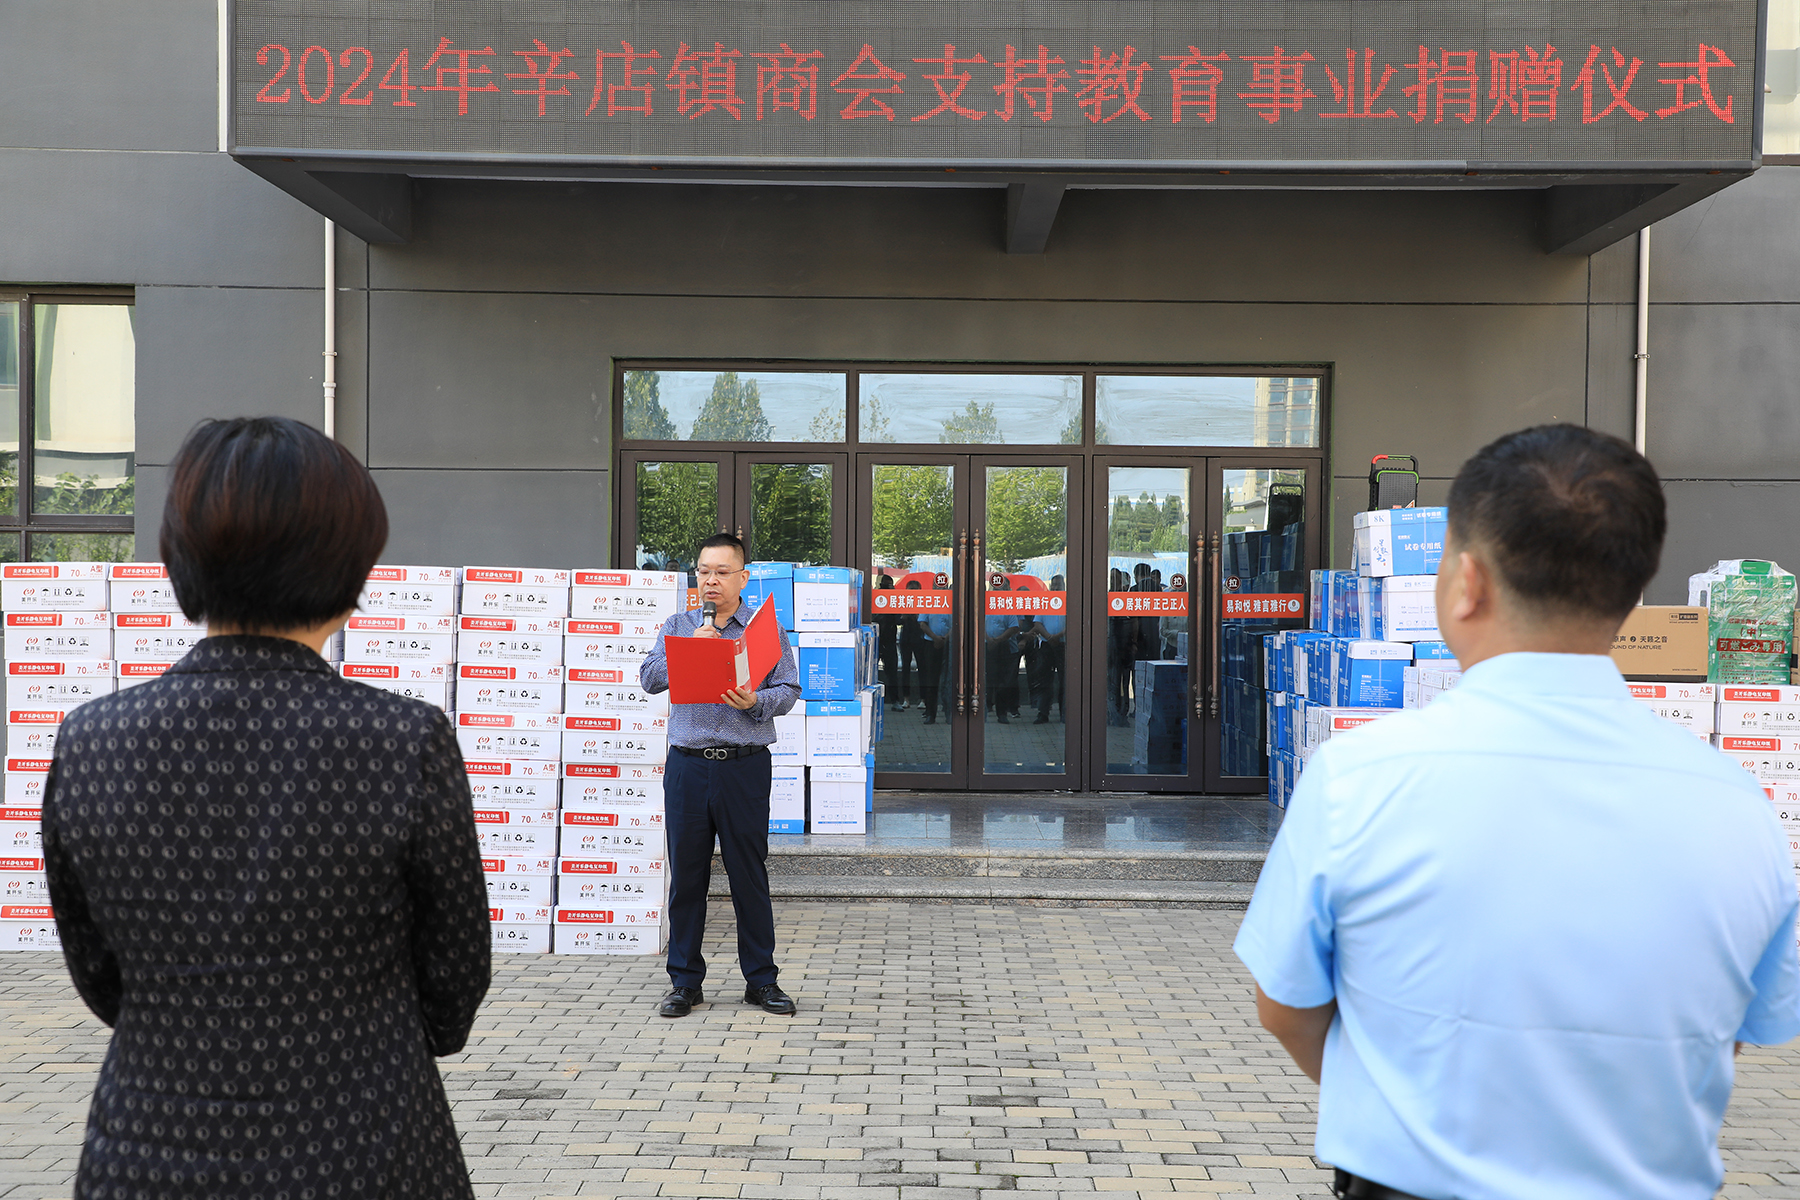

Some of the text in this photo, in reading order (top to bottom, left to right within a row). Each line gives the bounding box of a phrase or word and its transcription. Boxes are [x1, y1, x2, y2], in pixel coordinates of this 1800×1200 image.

[256, 38, 1736, 124] 2024年辛店镇商会支持教育事业捐赠仪式
[1405, 542, 1442, 551] 试卷专用纸
[937, 575, 946, 584] 拉
[993, 576, 1002, 585] 拉
[1173, 577, 1182, 586] 拉
[1228, 578, 1238, 588] 拉
[889, 595, 950, 608] 居其所 正己正人
[989, 596, 1050, 610] 易和悦 雅言雅行
[1126, 597, 1186, 611] 居其所 正己正人
[1226, 599, 1287, 613] 易和悦 雅言雅行
[1719, 640, 1783, 653] 可燃ごみ専用
